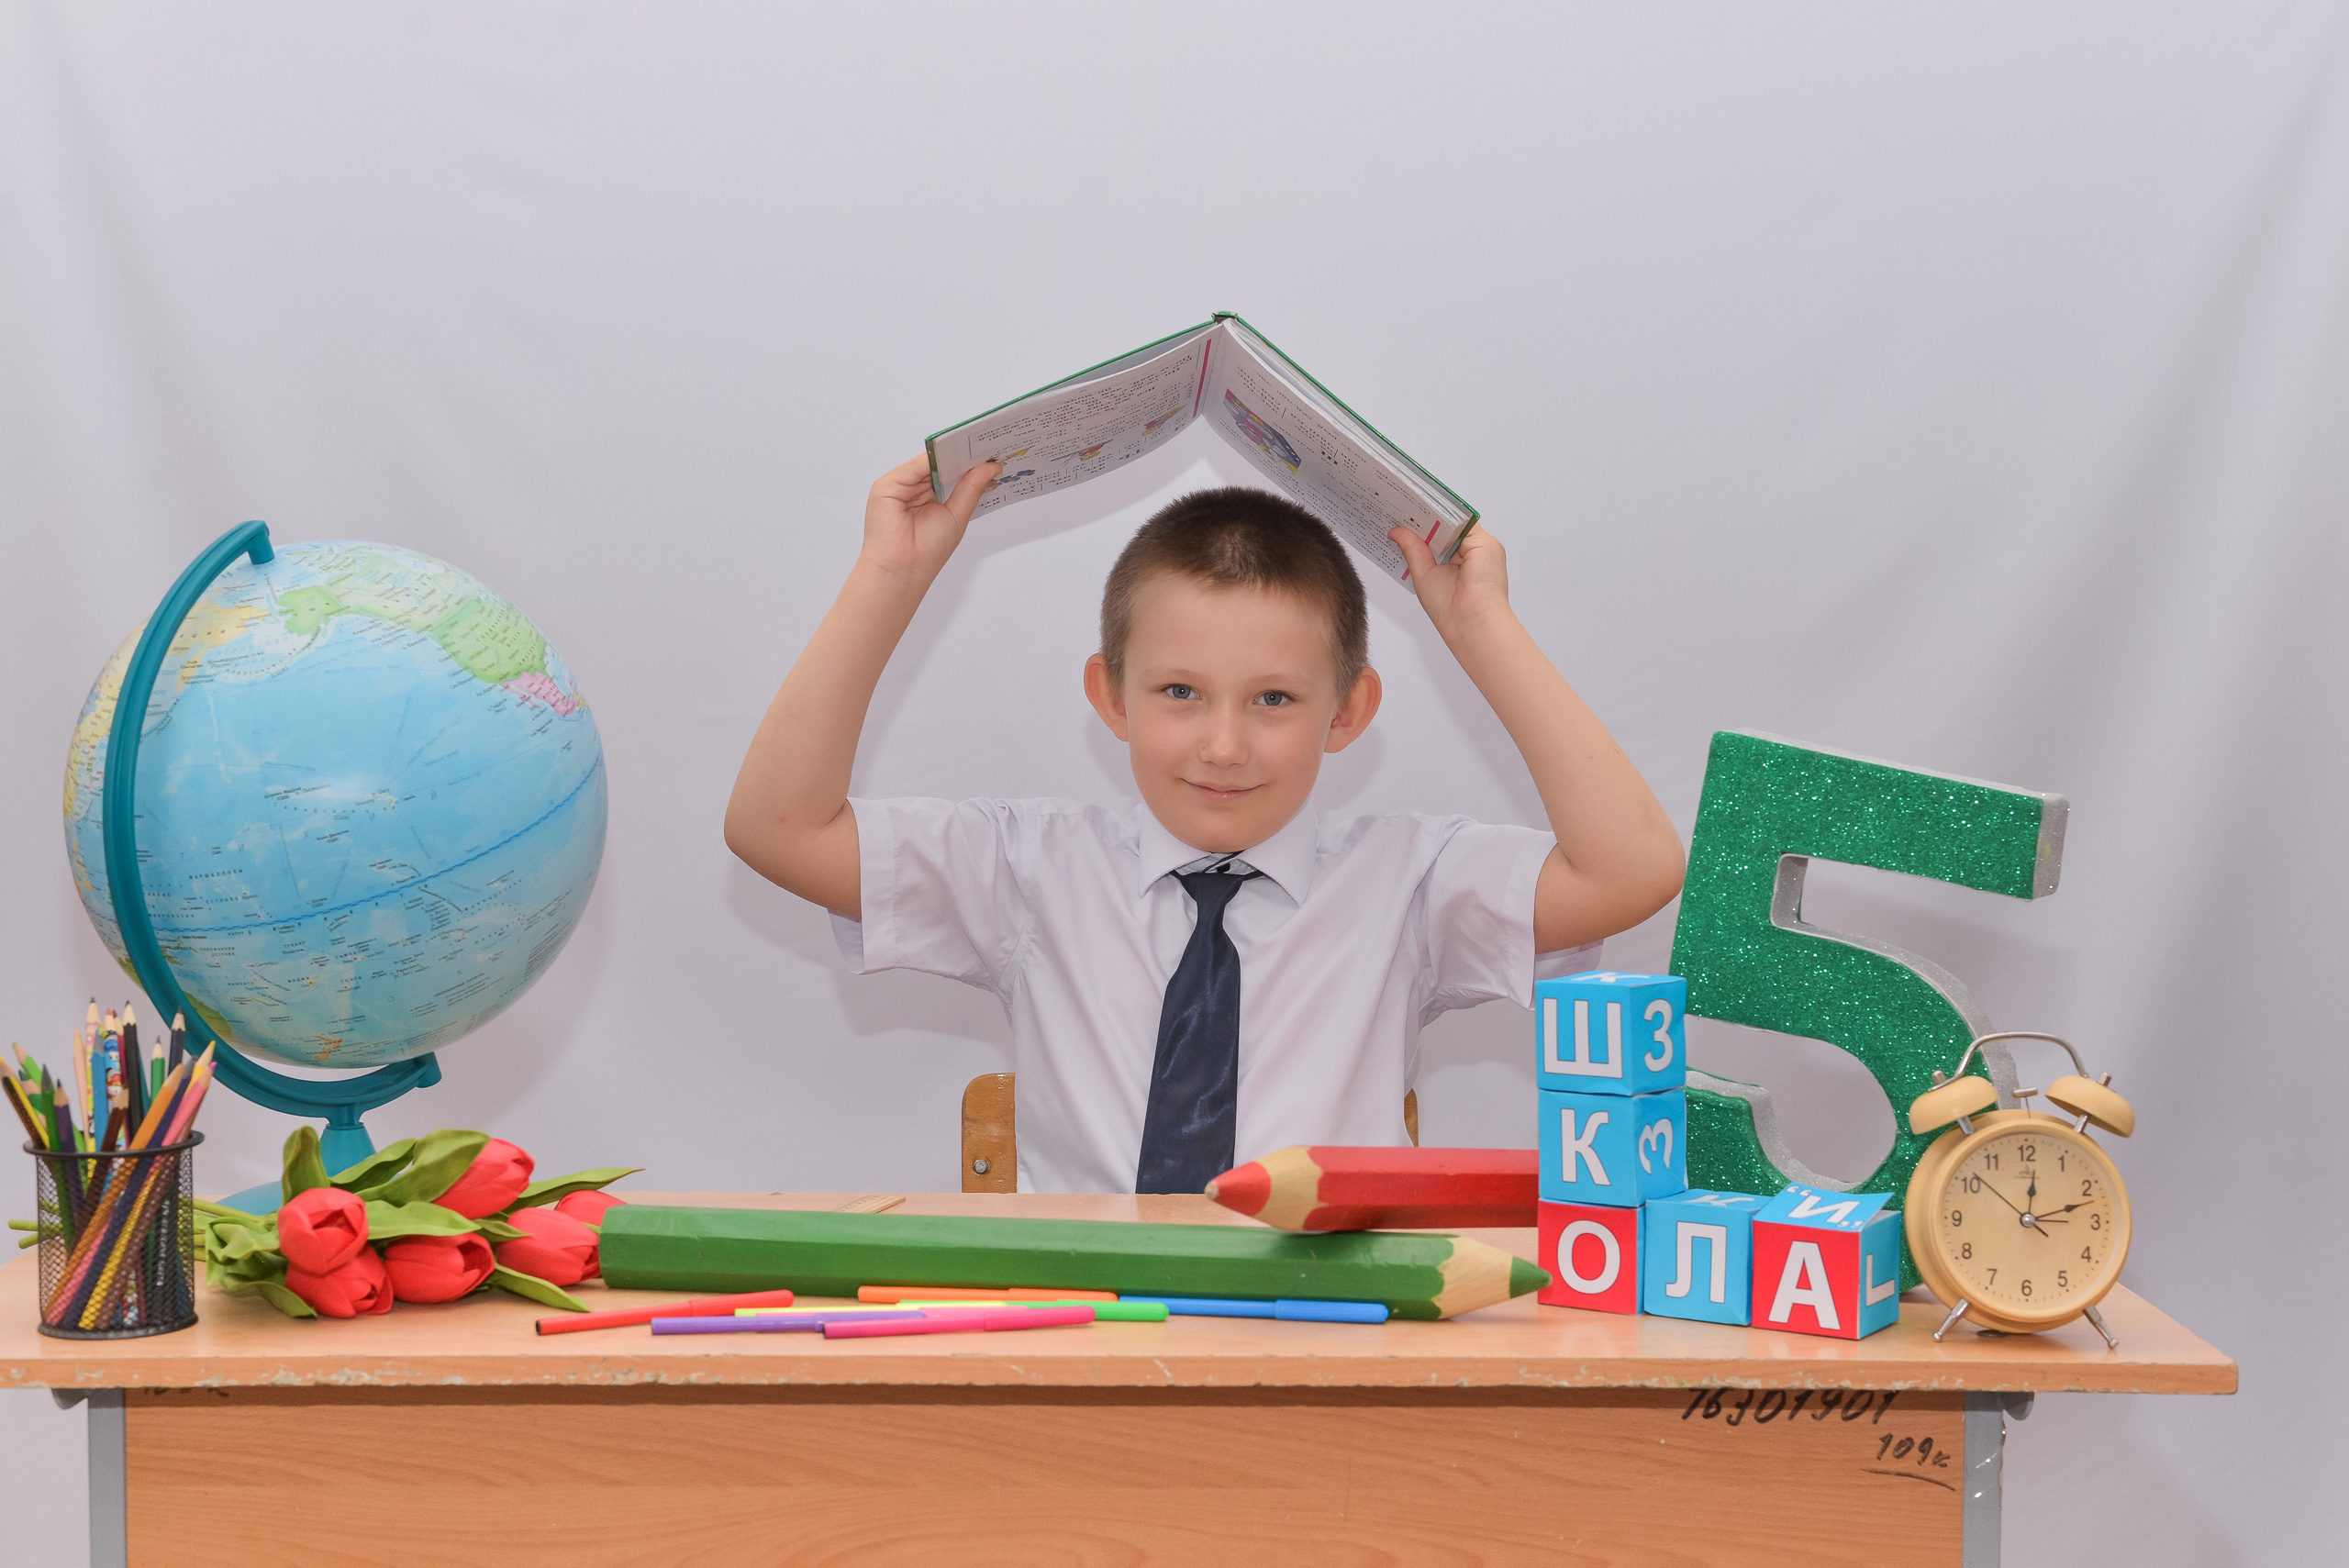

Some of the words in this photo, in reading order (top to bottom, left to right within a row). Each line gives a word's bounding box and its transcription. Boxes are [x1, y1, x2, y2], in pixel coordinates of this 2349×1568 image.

[1668, 730, 2070, 1292] 5
[1542, 997, 1623, 1079] Ш
[1560, 1107, 1611, 1187] К
[2018, 1144, 2036, 1162] 12
[1984, 1153, 1998, 1171] 11
[2058, 1155, 2065, 1173] 1
[1961, 1176, 1980, 1194] 10
[2082, 1179, 2092, 1196] 2
[1952, 1209, 1962, 1227] 9
[2090, 1213, 2101, 1230] 3
[1556, 1219, 1621, 1295] О
[1962, 1242, 1972, 1260] 8
[2081, 1246, 2092, 1262] 4
[1664, 1221, 1728, 1304] Л
[1767, 1240, 1841, 1330] А
[1987, 1268, 1998, 1285] 7
[2057, 1270, 2068, 1287] 5
[2021, 1279, 2032, 1296] 6
